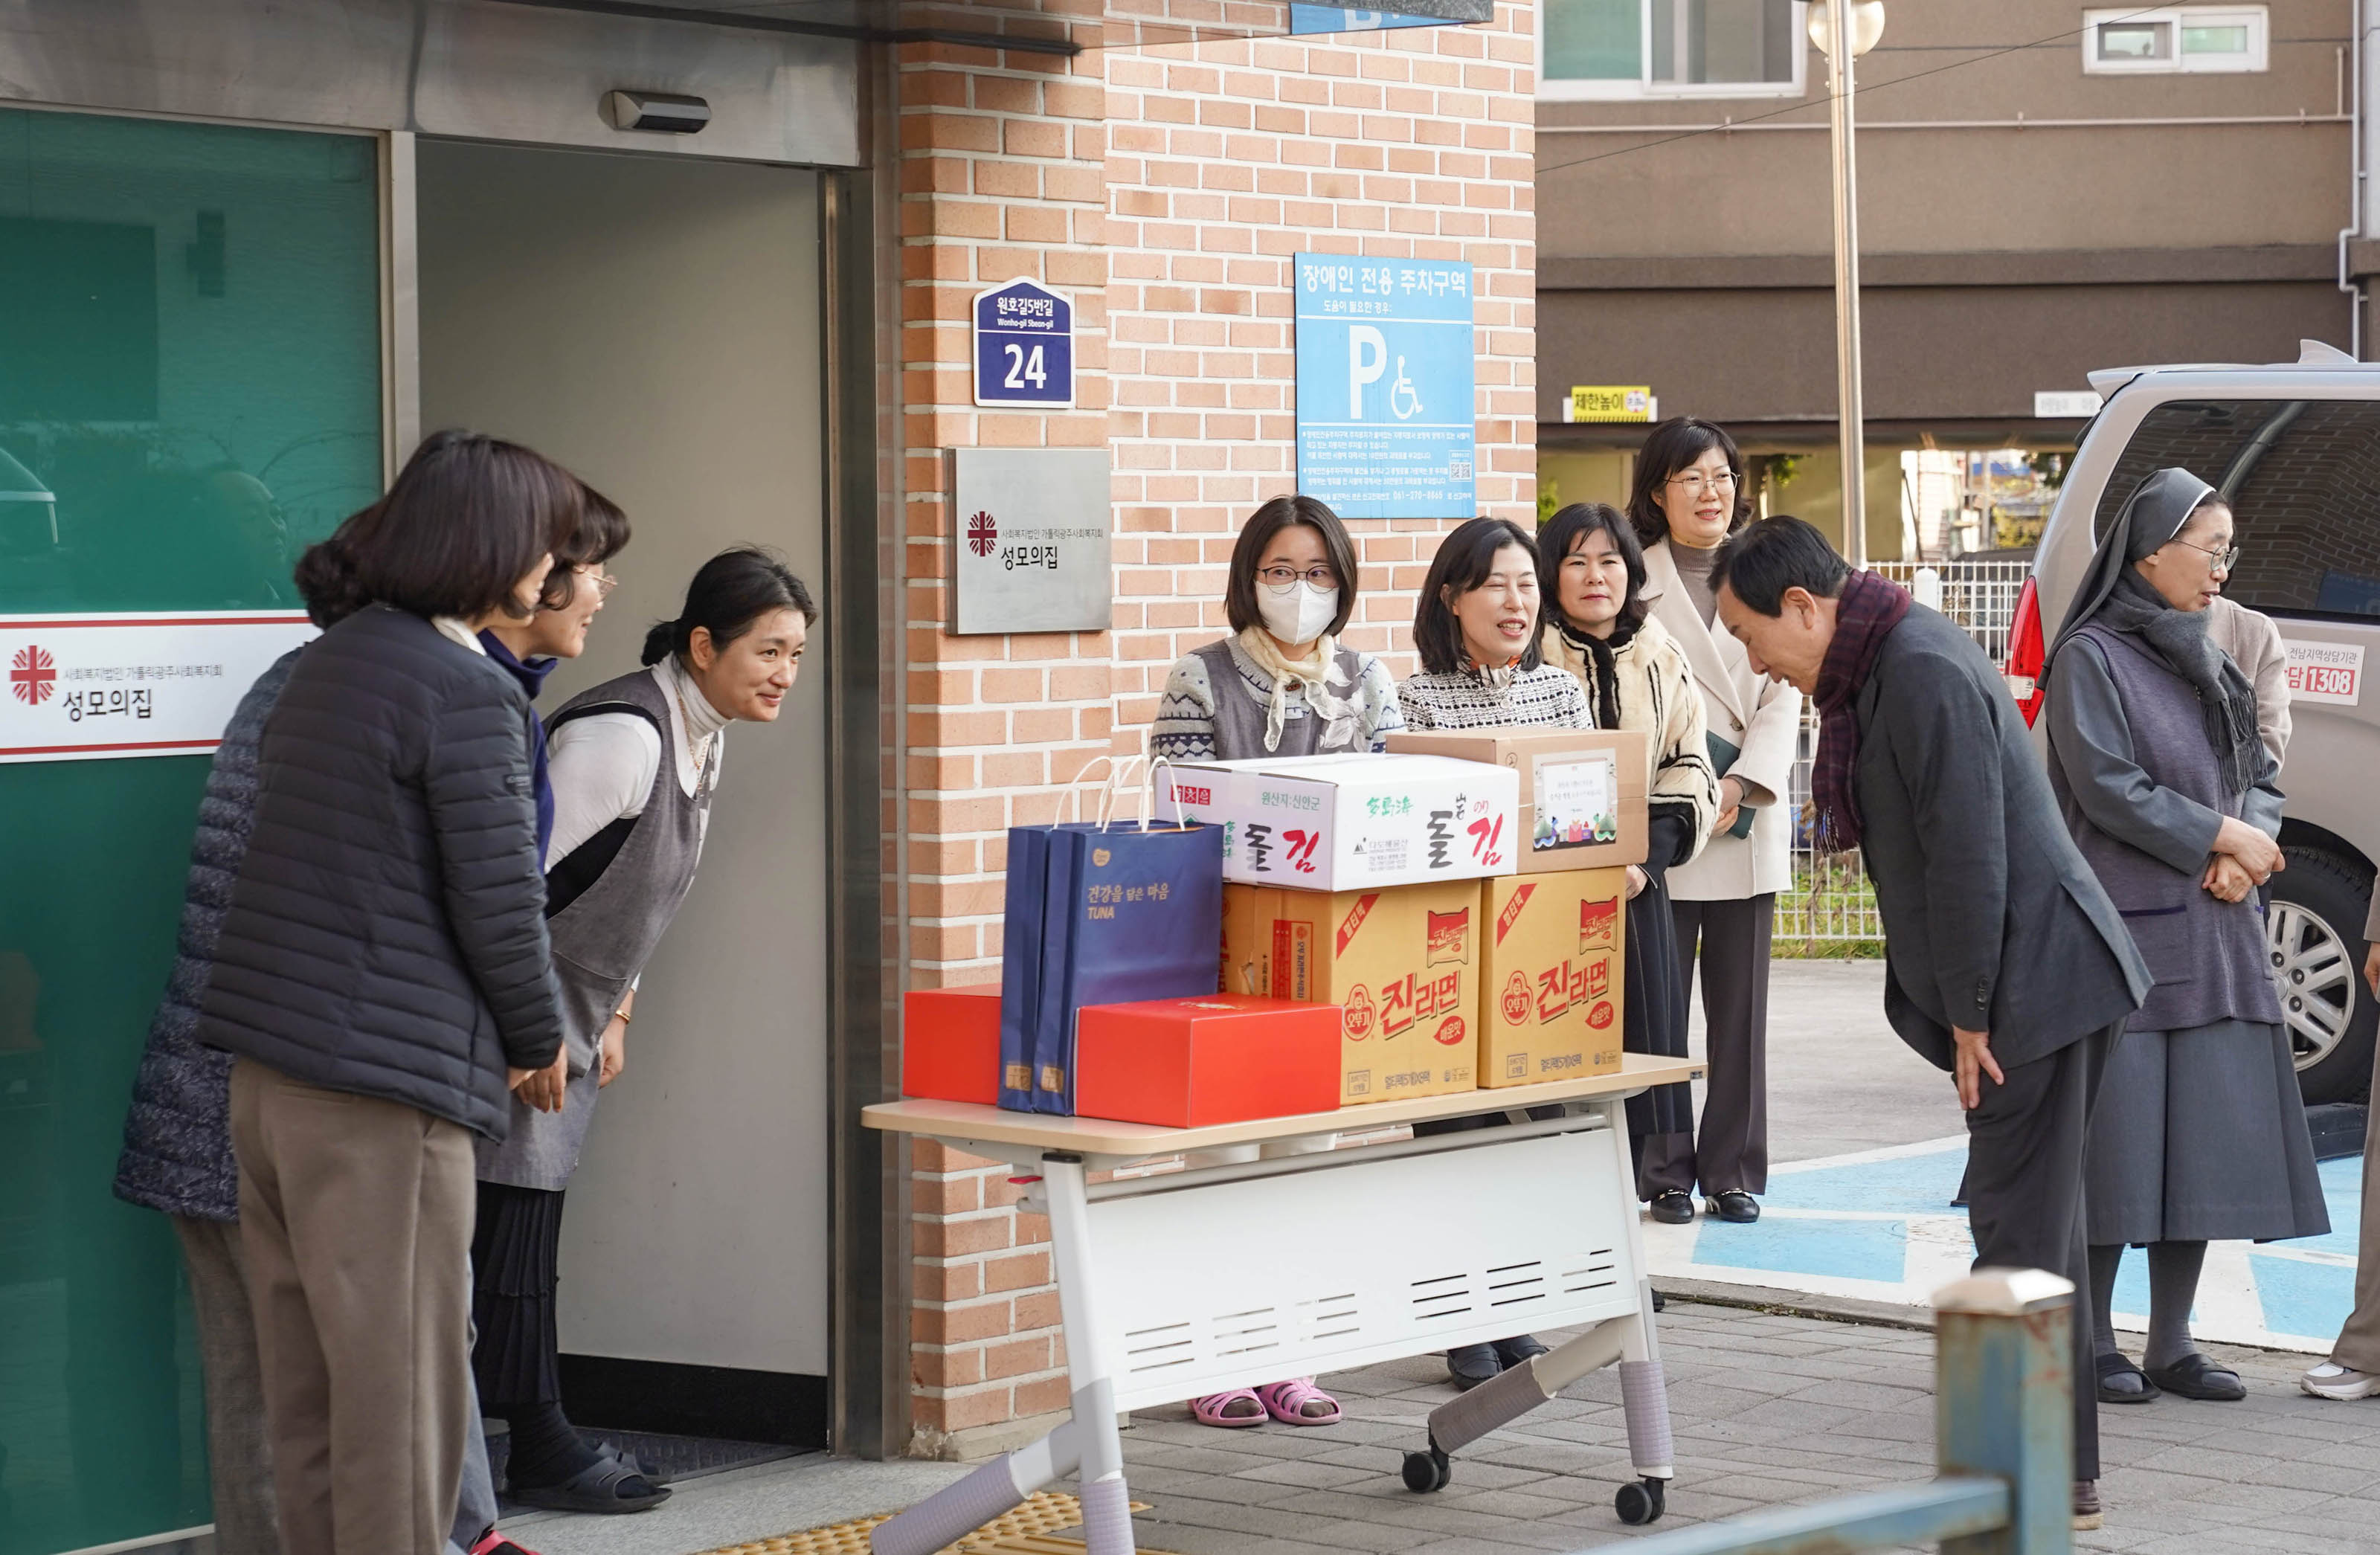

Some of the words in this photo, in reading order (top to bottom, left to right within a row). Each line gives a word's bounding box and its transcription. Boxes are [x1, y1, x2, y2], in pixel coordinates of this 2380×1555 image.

[1303, 265, 1354, 293] 장애인
[1361, 267, 1393, 295] 전용
[1400, 269, 1465, 297] 주차구역
[997, 297, 1053, 317] 원호길5번길
[997, 318, 1026, 329] Wonho-gil
[1028, 319, 1054, 329] 5beon-gil
[1004, 344, 1046, 389] 24
[1349, 325, 1387, 419] P
[1575, 393, 1624, 411] 제한높이
[1002, 528, 1040, 540] 사회복지법인
[1041, 528, 1104, 540] 가톨릭광주사회복지회
[1001, 546, 1058, 571] 성모의집
[2290, 648, 2358, 665] 전남지역상담기관
[63, 667, 123, 681] 사회복지법인
[2284, 666, 2304, 689] 담
[2309, 668, 2351, 694] 1308
[62, 689, 152, 723] 성모의집
[1087, 883, 1124, 904] 건강을
[1148, 882, 1170, 901] 마음
[1087, 906, 1115, 920] TUNA
[1537, 957, 1609, 1025] 진라면
[1380, 970, 1461, 1040] 진라면
[1506, 997, 1528, 1014] 오뚜기
[1591, 1005, 1610, 1026] 매운맛
[1346, 1011, 1371, 1028] 오뚜기
[1440, 1021, 1461, 1042] 매운맛
